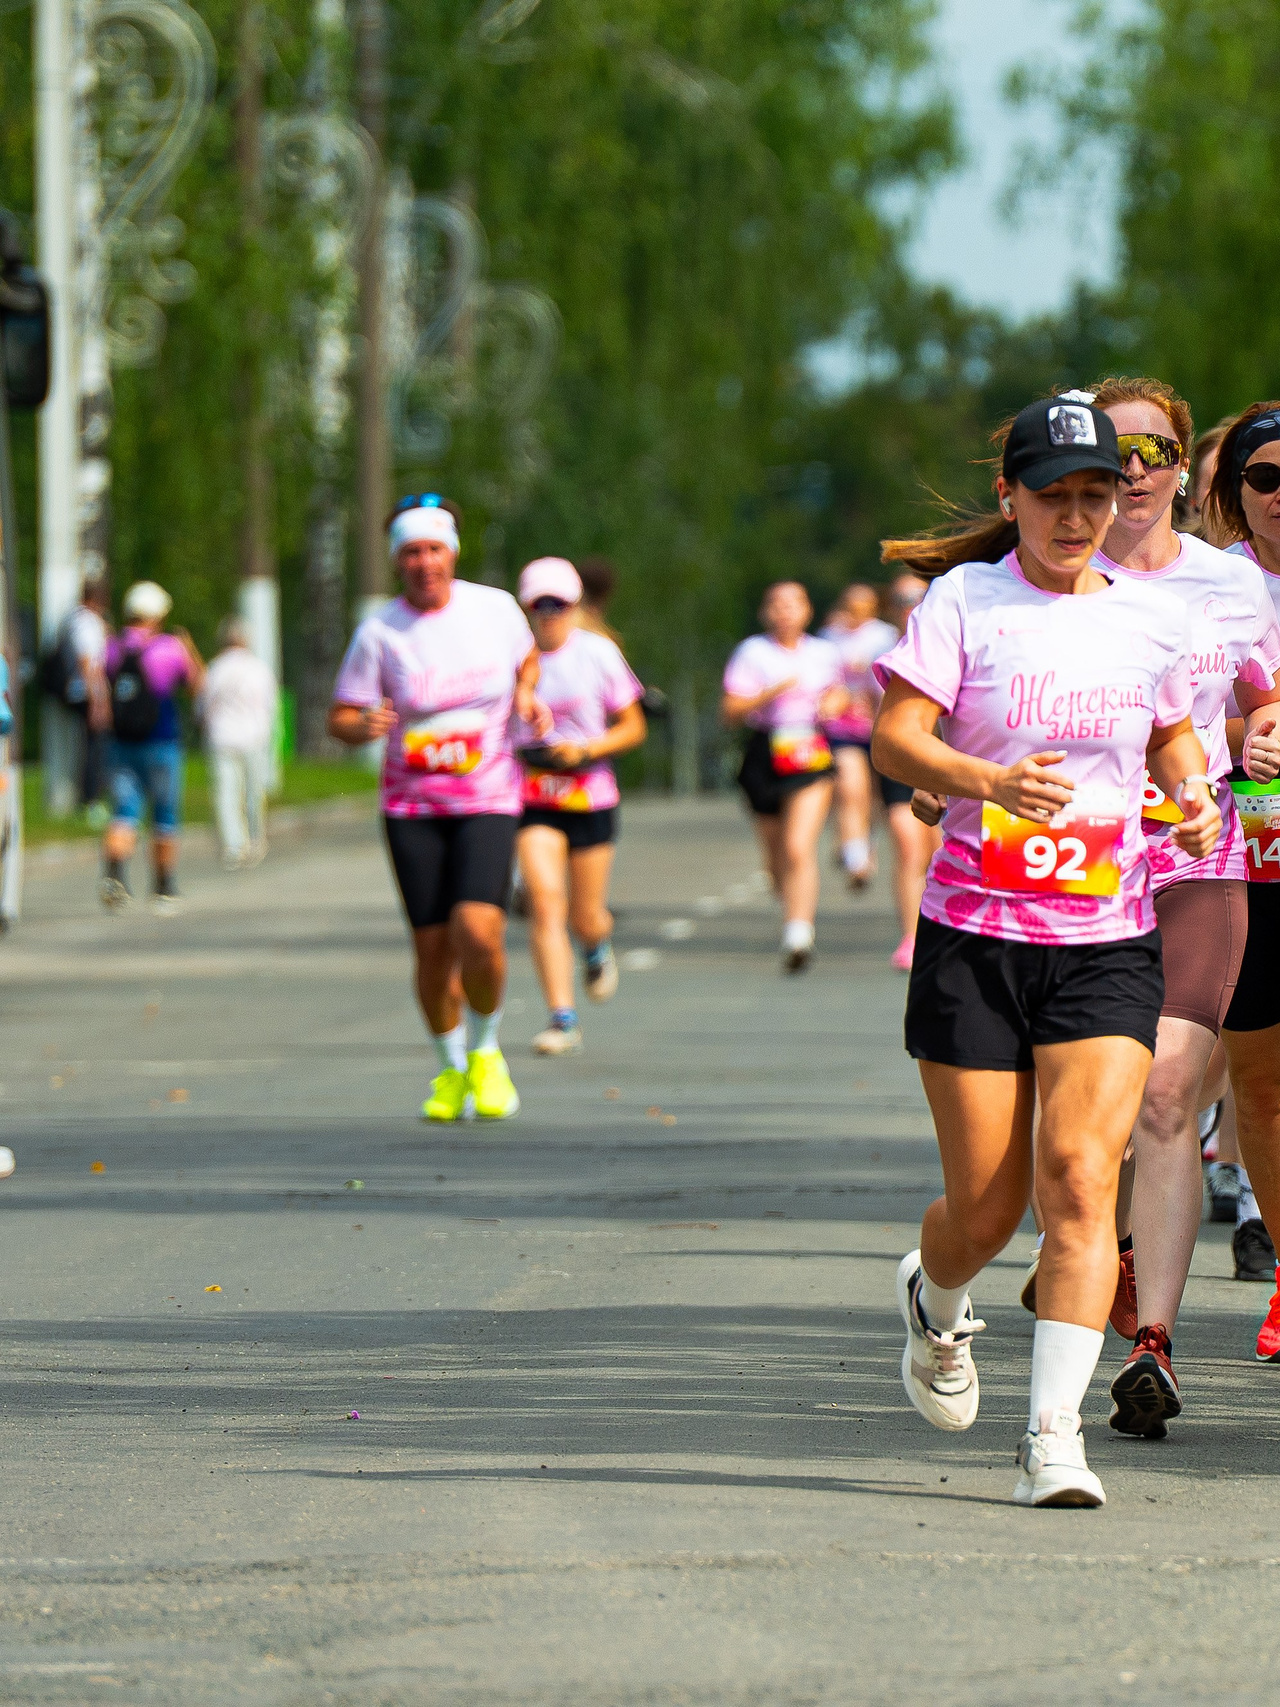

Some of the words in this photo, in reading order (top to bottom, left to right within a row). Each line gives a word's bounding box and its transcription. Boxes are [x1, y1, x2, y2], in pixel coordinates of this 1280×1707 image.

[1006, 670, 1146, 730] Женский
[1046, 718, 1121, 740] ЗАБЕГ
[1022, 834, 1088, 882] 92
